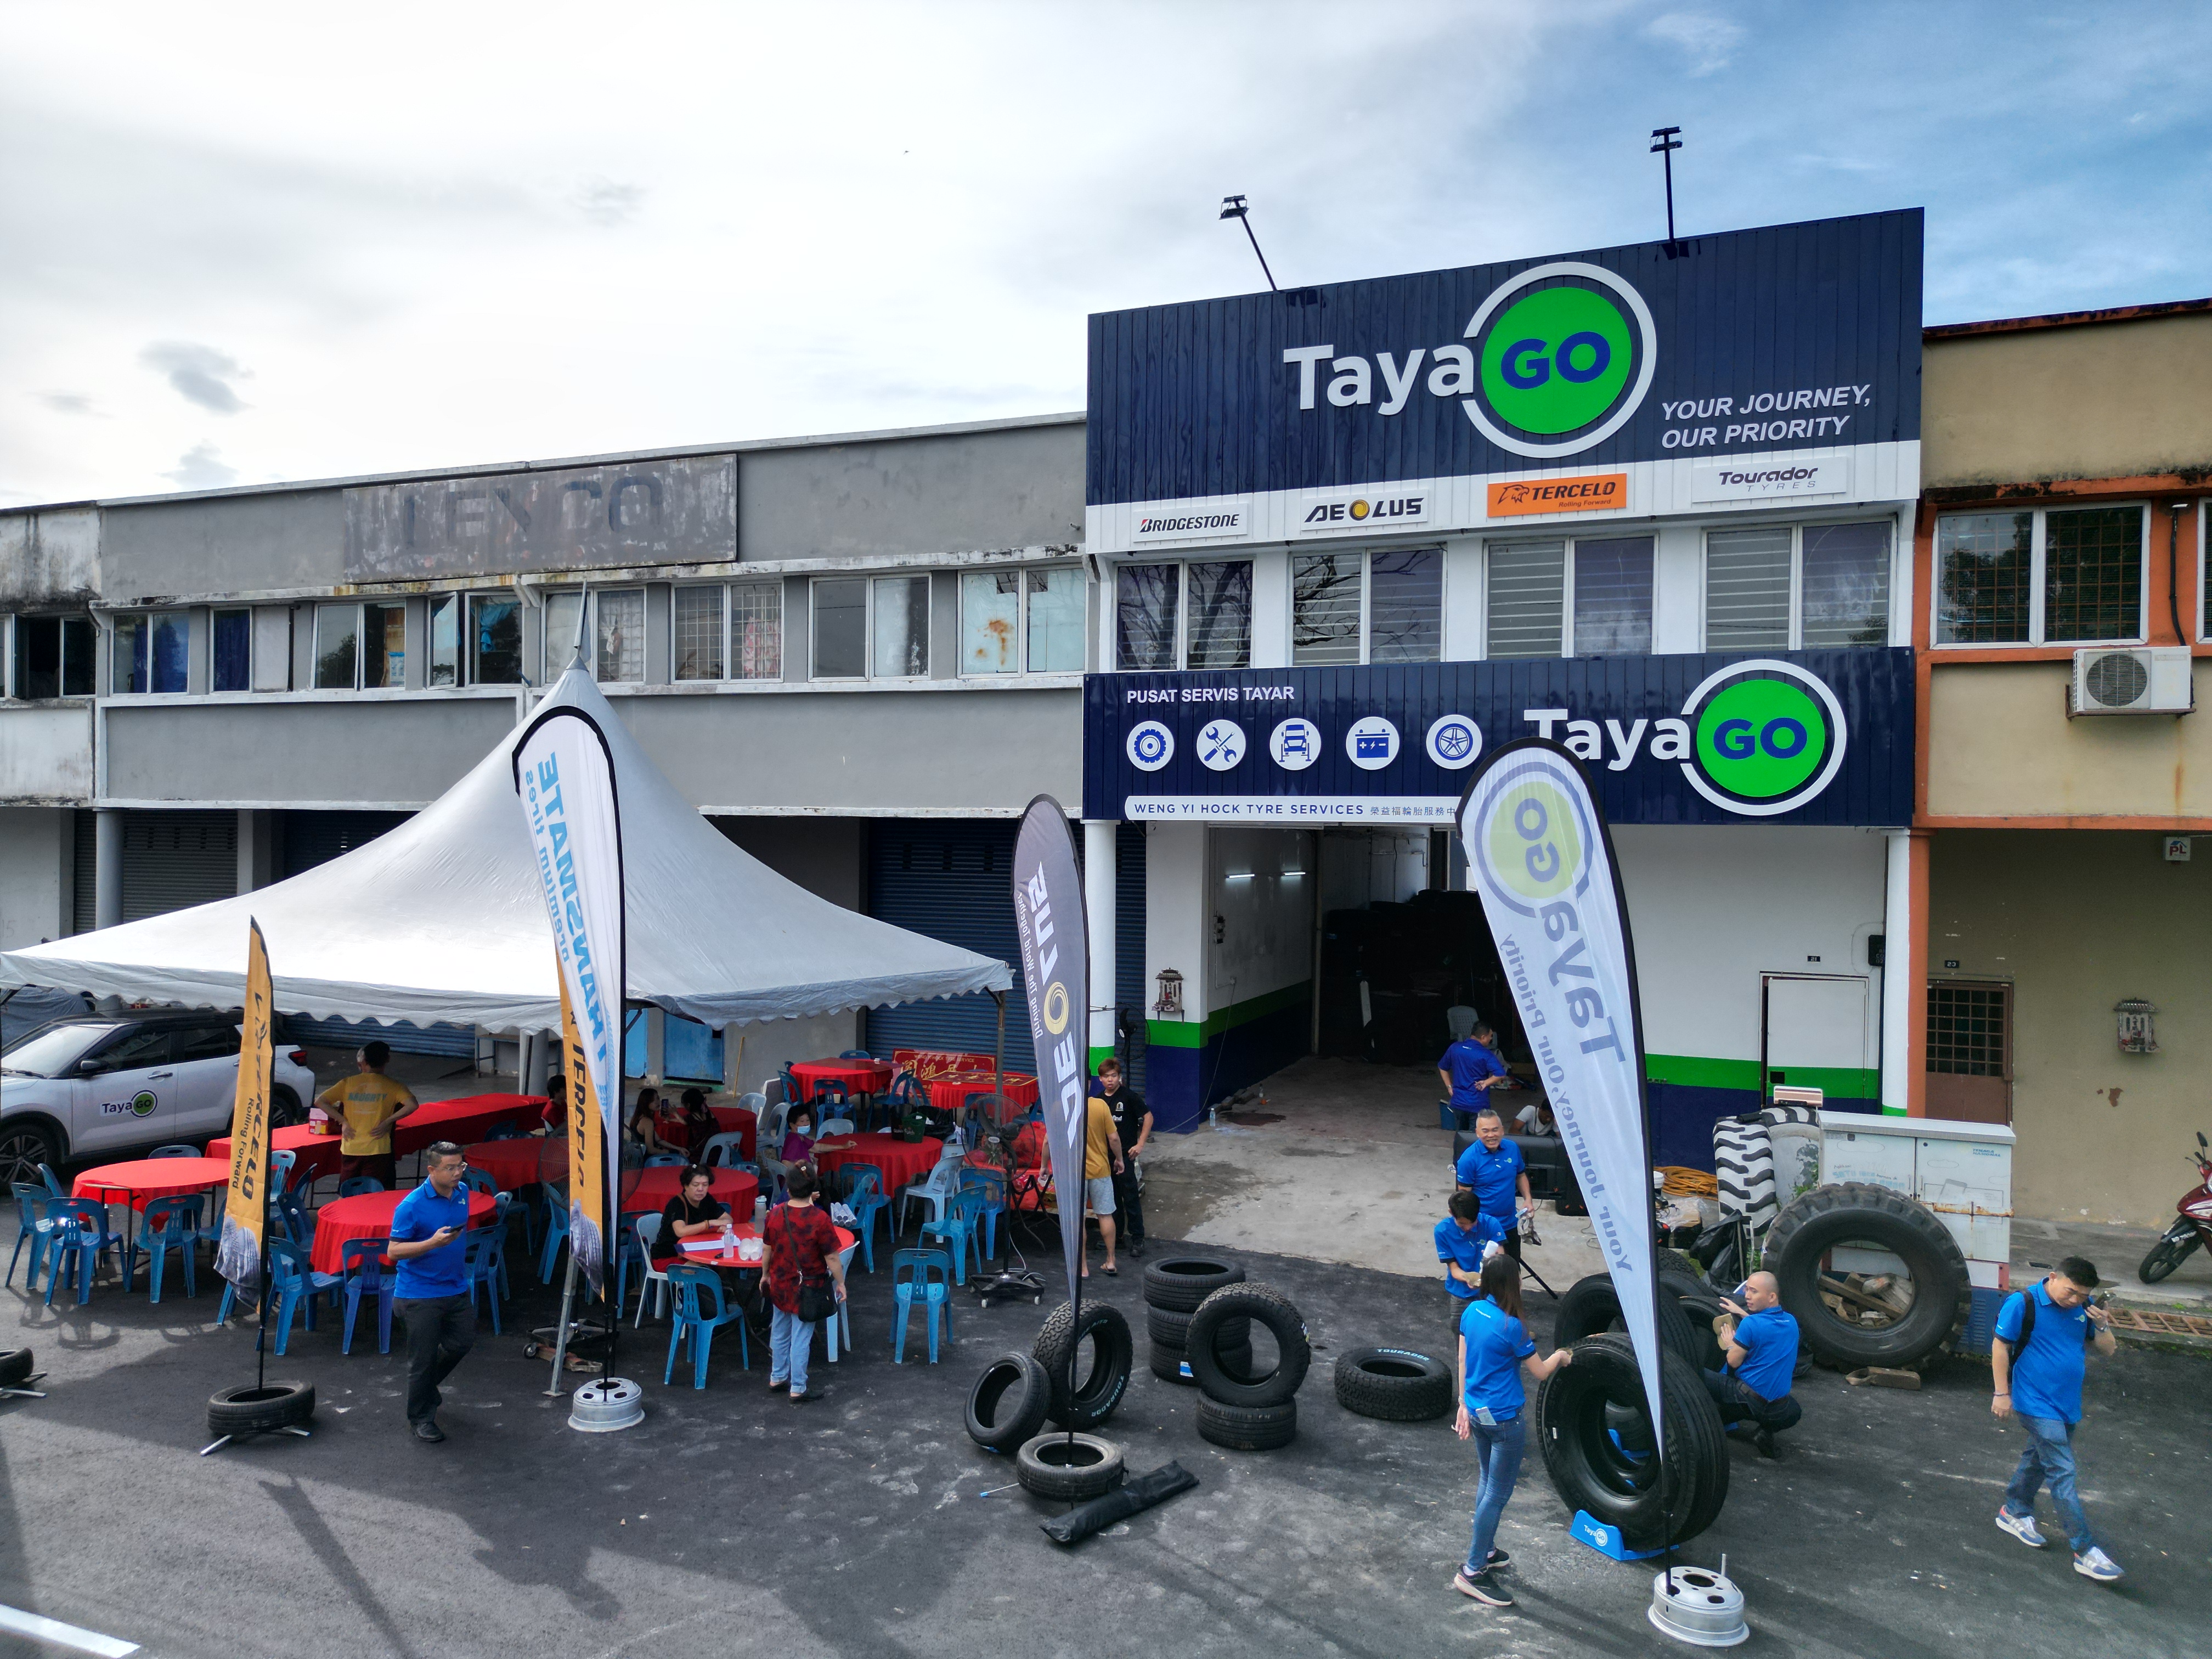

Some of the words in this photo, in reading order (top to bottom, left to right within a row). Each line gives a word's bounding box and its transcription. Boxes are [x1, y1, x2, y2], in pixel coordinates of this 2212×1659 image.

[1283, 343, 1474, 416] Taya
[1500, 330, 1611, 390] GO
[1662, 397, 1733, 421] YOUR
[1740, 385, 1871, 415] JOURNEY,
[1661, 427, 1717, 449] OUR
[1724, 415, 1850, 444] PRIORITY
[1718, 466, 1819, 486] Tourador
[1532, 481, 1616, 501] TERCELO
[1746, 481, 1816, 492] TYRES
[1304, 497, 1425, 523] AEOLUS
[1139, 514, 1240, 533] BRIDGESTONE
[1127, 689, 1178, 703] PUSAT
[1181, 687, 1239, 702] SERVIS
[1243, 686, 1295, 701] TAYAR
[1523, 708, 1691, 771] Taya
[1713, 716, 1808, 761] GO
[1134, 803, 1176, 814] WENG
[1181, 804, 1195, 814] YI
[1201, 804, 1241, 814] HOCK
[1246, 804, 1284, 815] TYRE
[1290, 804, 1364, 815] SERVICES
[101, 1102, 132, 1114] Taya
[136, 1099, 152, 1109] GO
[240, 1097, 255, 1137] Rolling
[232, 1140, 249, 1189] Forward
[1376, 1348, 1430, 1362] TOURADOR
[1091, 1375, 1125, 1417] TOURADOR
[1583, 1525, 1596, 1537] Taya
